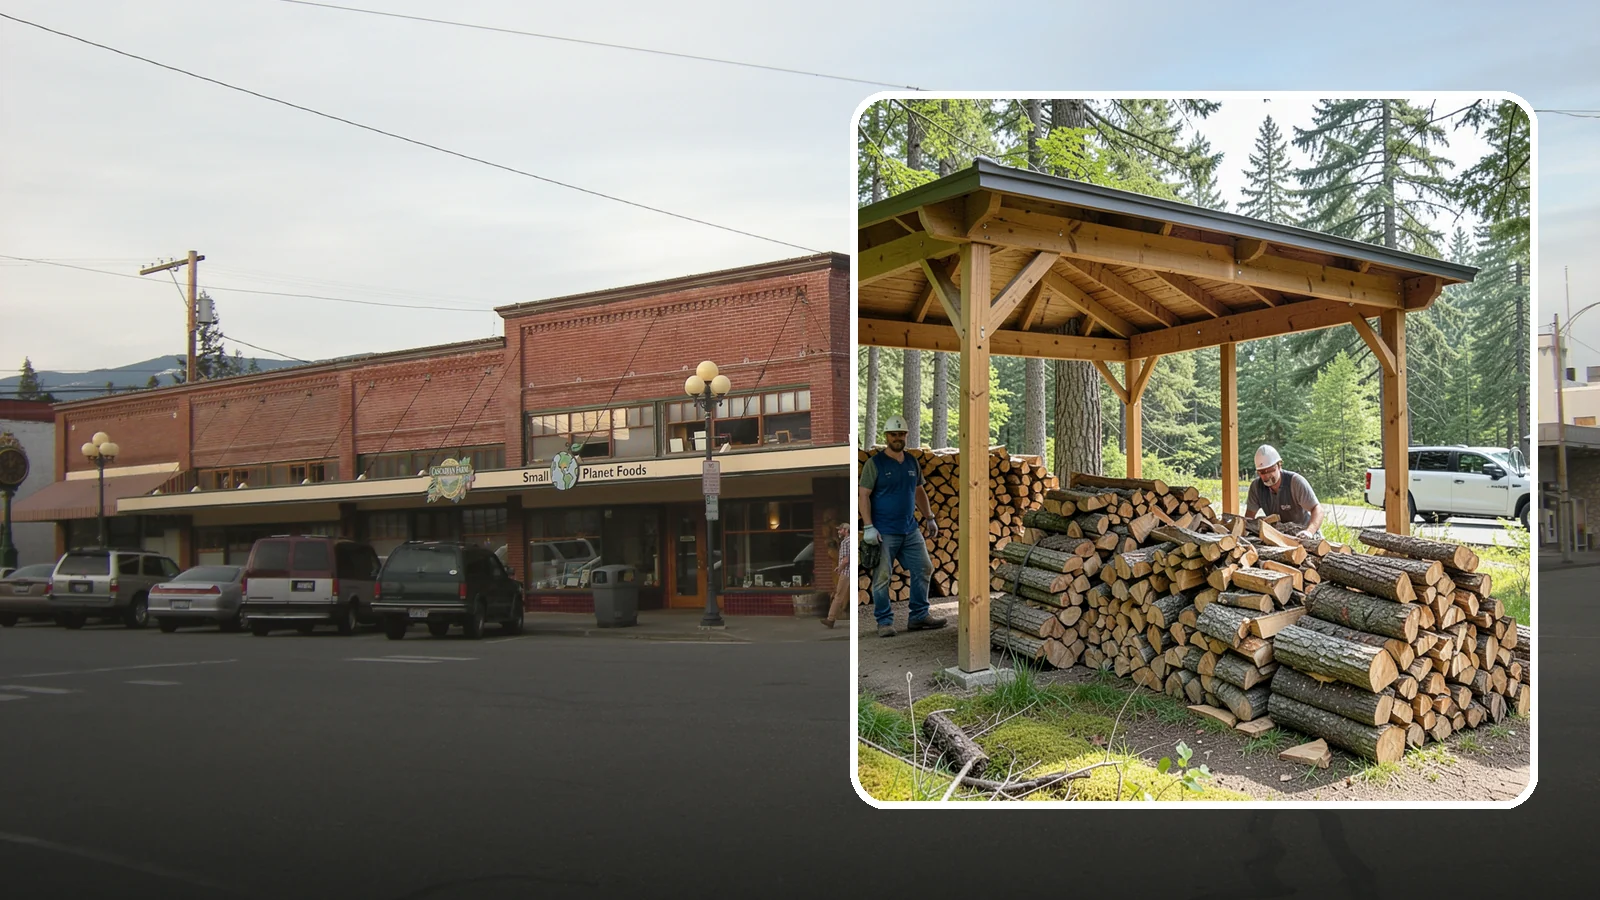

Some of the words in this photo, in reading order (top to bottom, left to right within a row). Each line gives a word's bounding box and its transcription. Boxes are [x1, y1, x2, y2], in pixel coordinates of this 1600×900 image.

[431, 467, 455, 476] CASCADIAN
[455, 465, 469, 474] FARM
[523, 470, 549, 483] Small
[583, 467, 614, 479] Planet
[617, 464, 647, 477] Foods
